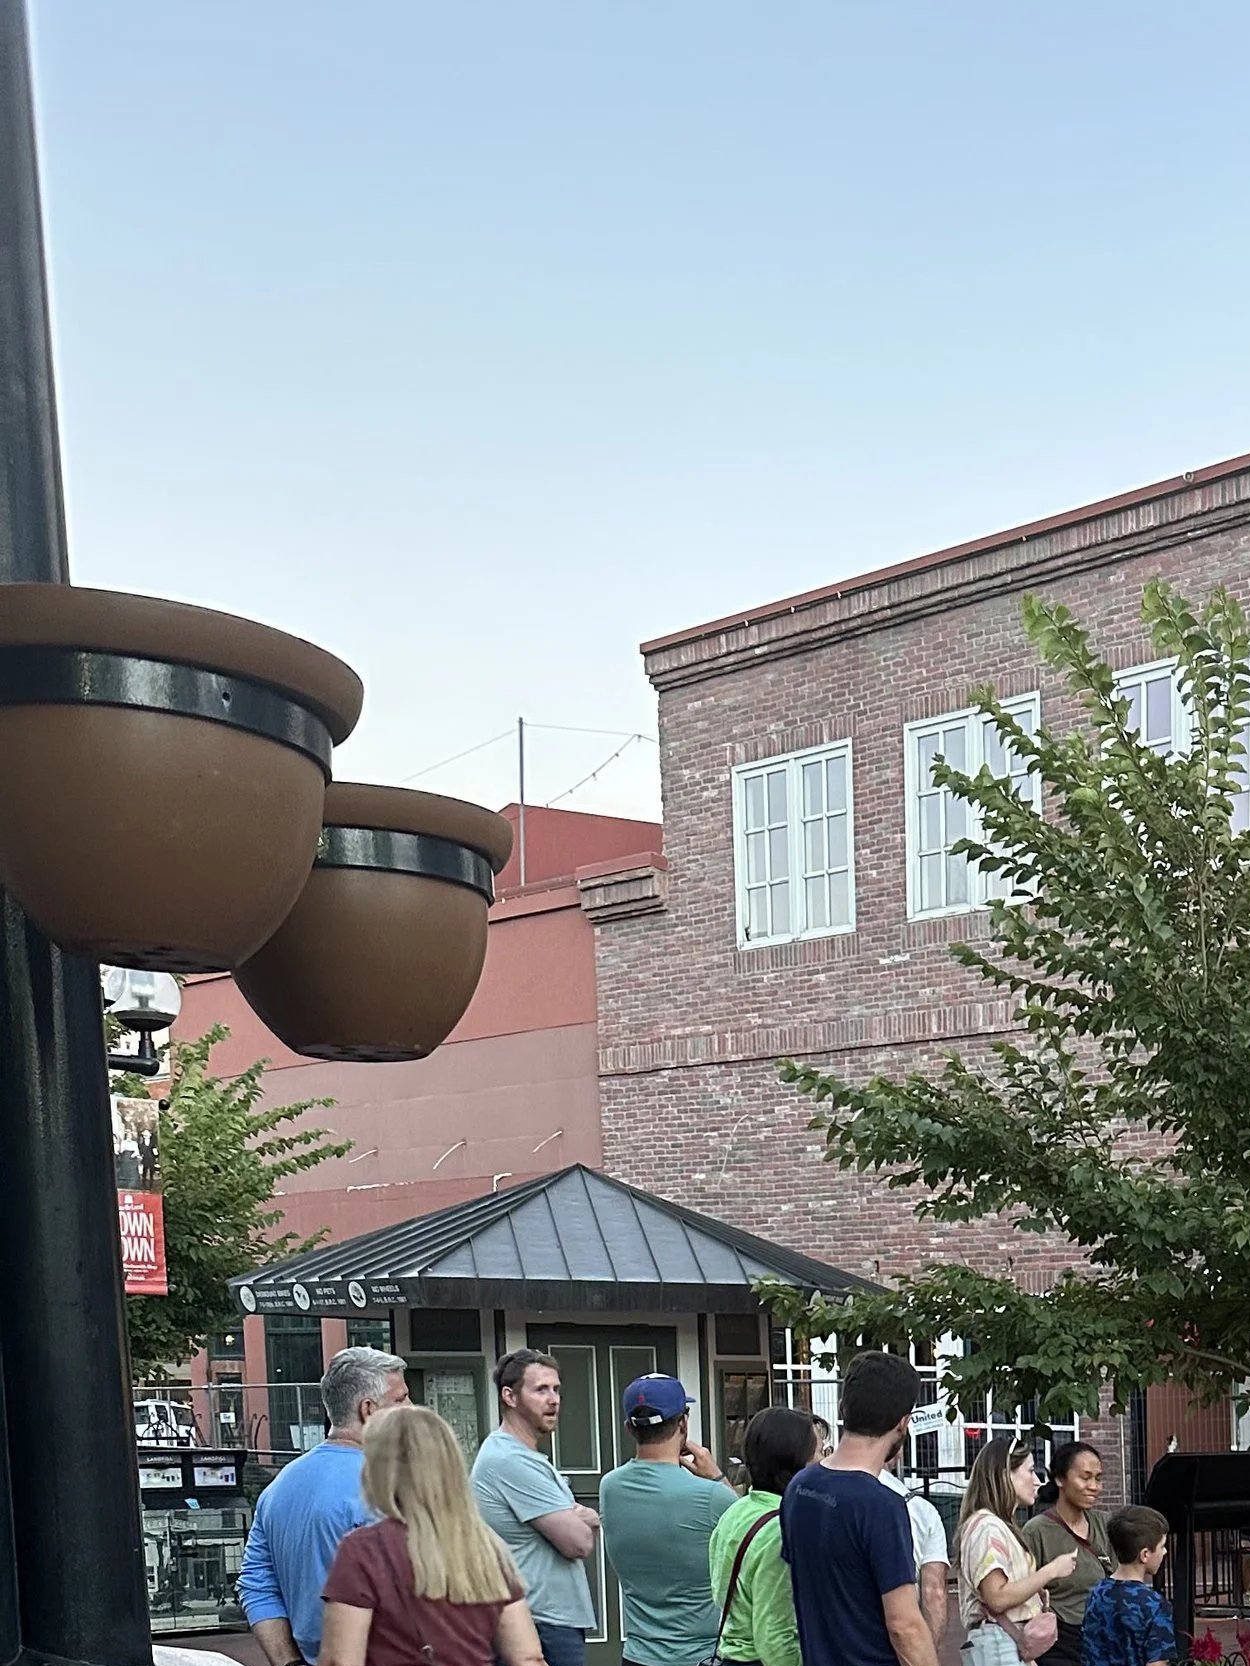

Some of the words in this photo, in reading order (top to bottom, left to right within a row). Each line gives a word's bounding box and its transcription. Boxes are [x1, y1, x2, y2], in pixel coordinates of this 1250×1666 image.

[119, 1211, 154, 1237] OWN
[121, 1237, 155, 1262] OWN
[912, 1410, 943, 1424] United
